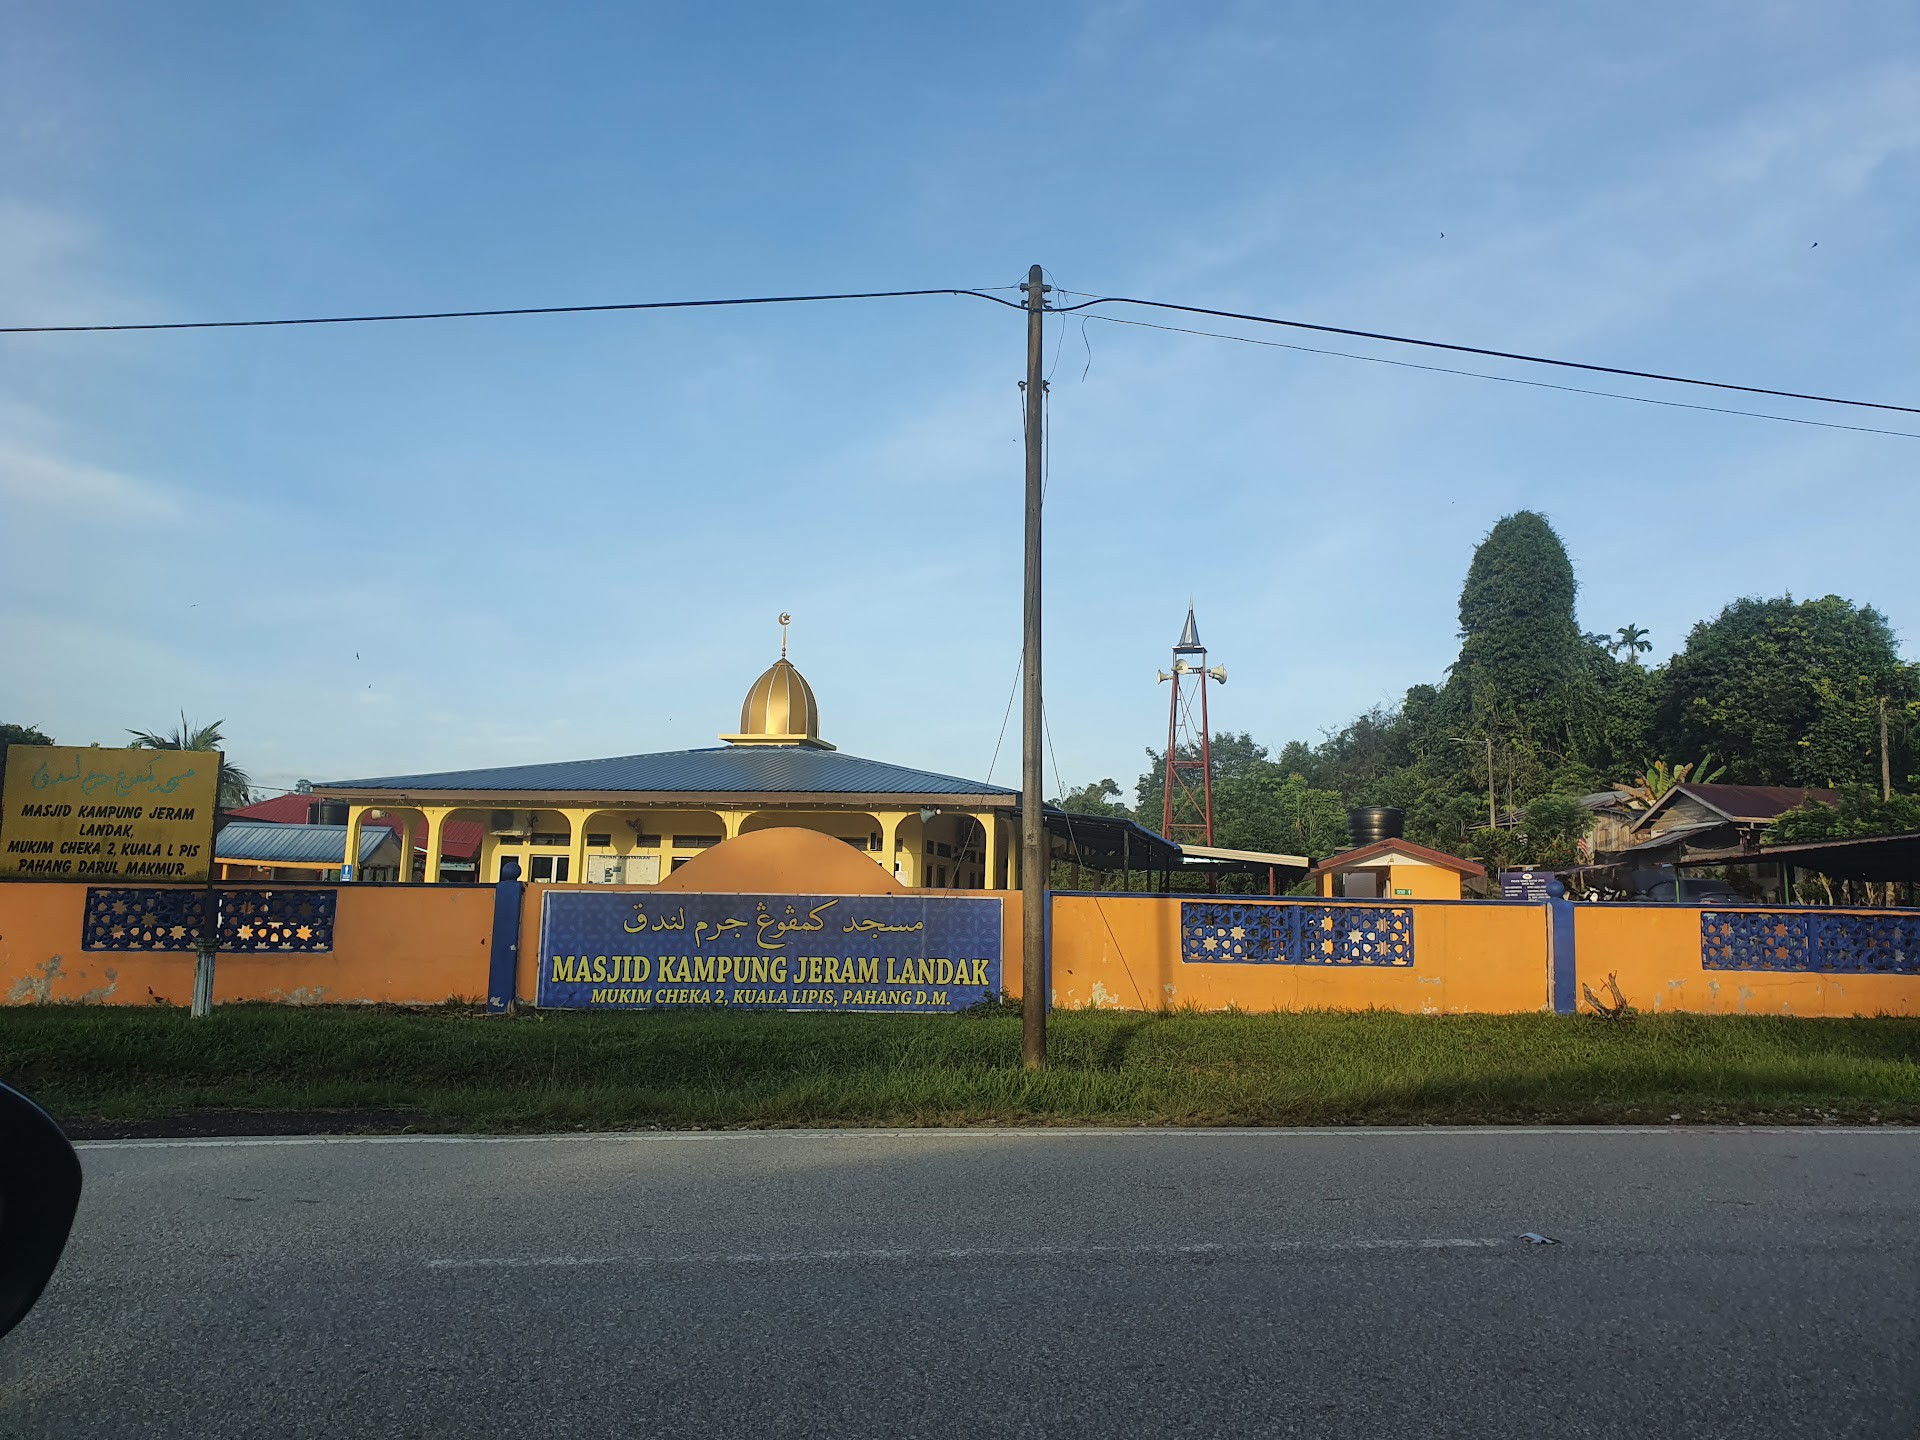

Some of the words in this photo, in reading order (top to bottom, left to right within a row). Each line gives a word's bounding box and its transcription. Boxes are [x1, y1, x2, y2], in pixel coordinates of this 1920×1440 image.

[21, 804, 72, 818] MASJID
[77, 805, 143, 819] KAMPUNG
[149, 806, 196, 821] JERAM
[79, 824, 134, 839] LANDAK,
[7, 840, 55, 854] MUKIM
[60, 841, 101, 855] CHEKA
[107, 842, 117, 857] 2,
[120, 843, 161, 856] KUALA
[18, 859, 72, 873] PAHANG
[78, 860, 119, 875] DARUL
[125, 862, 187, 876] MAKMUR.
[623, 903, 686, 933] لندق
[842, 916, 924, 939] مسجد
[694, 915, 749, 948] جرم
[551, 955, 651, 983] MASJID
[657, 955, 787, 984] KAMPUNG
[793, 956, 880, 984] JERAM
[886, 957, 989, 986] LANDAK
[590, 988, 652, 1004] MUKIM
[655, 989, 711, 1004] CHEKA
[714, 989, 729, 1006] 2,
[732, 989, 788, 1005] KUALA
[791, 989, 838, 1007] LIPIS,
[842, 990, 912, 1005] PAHANG
[914, 991, 951, 1006] D.M.
